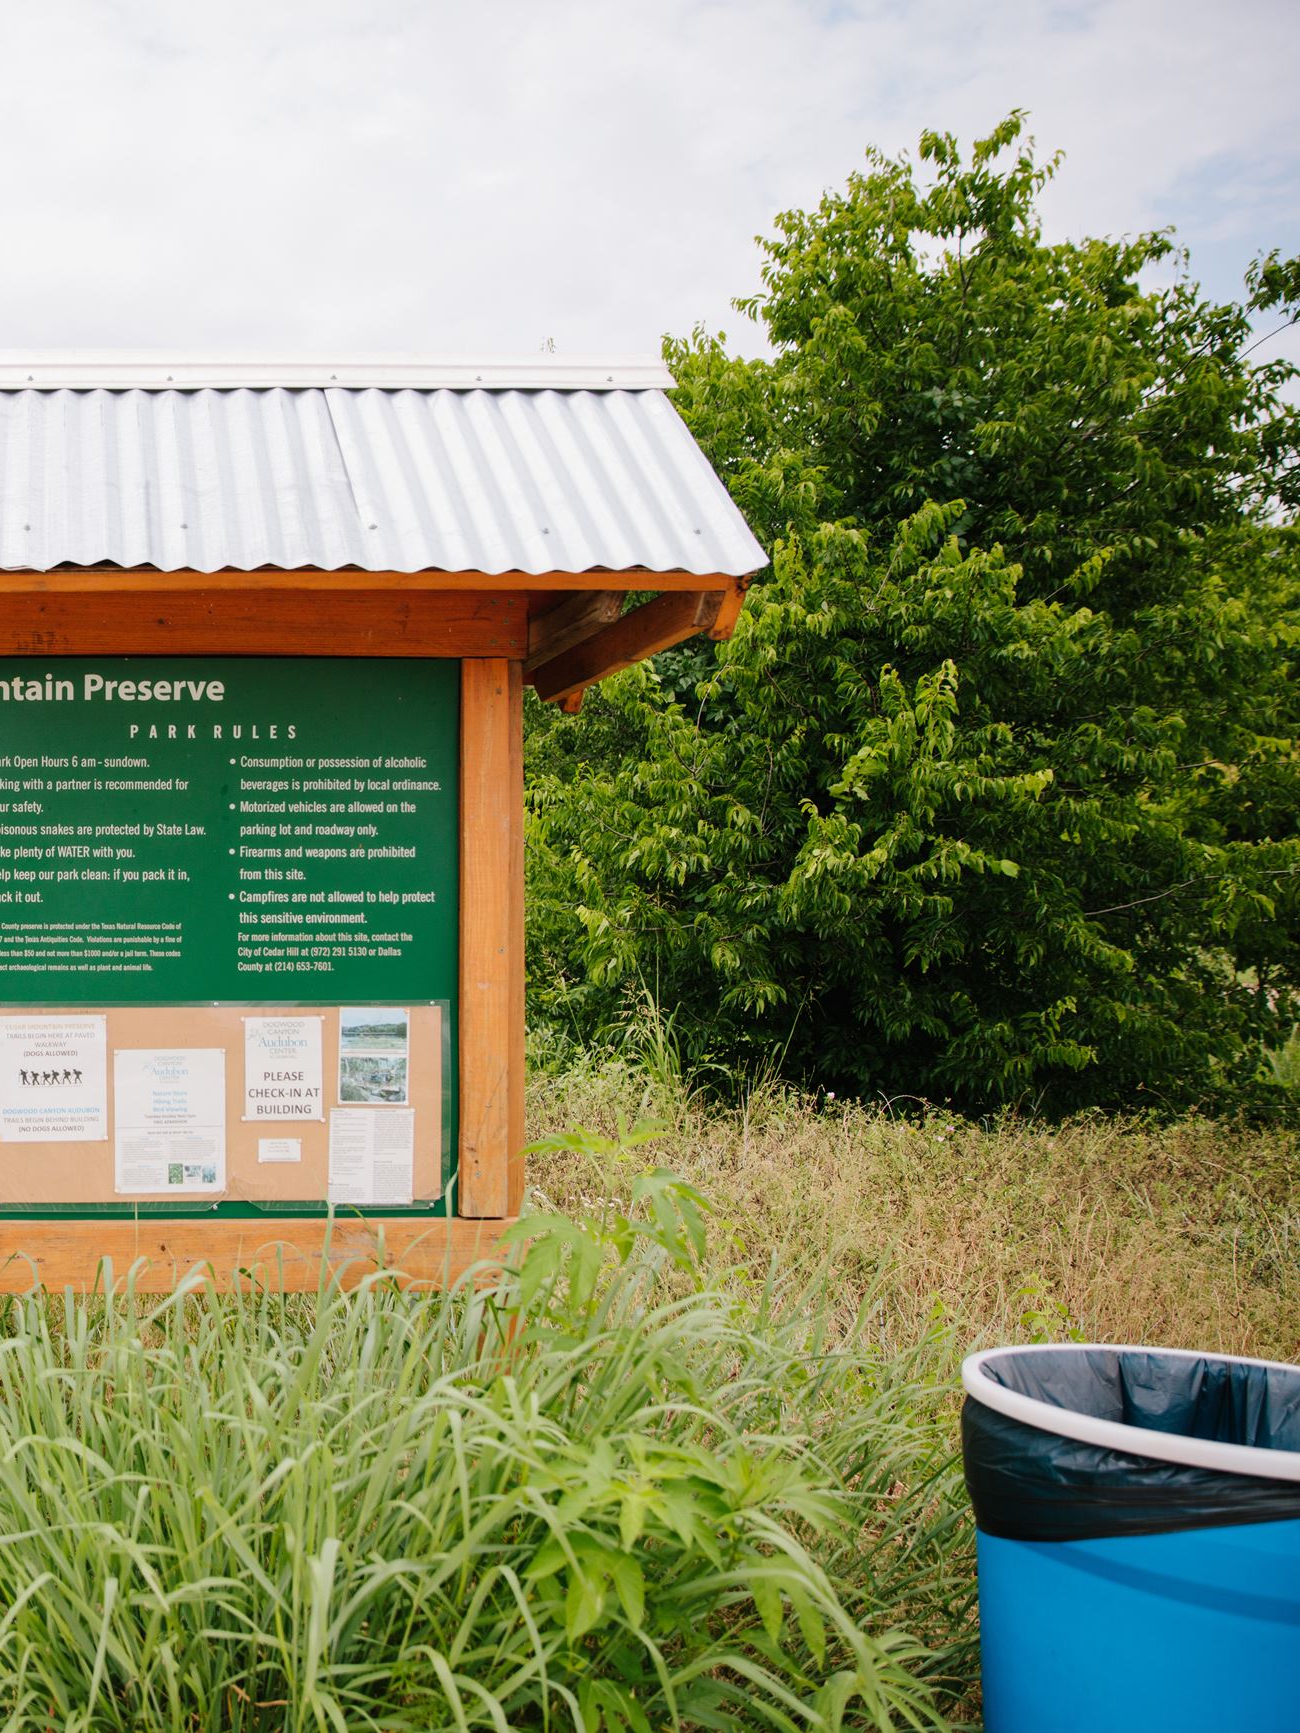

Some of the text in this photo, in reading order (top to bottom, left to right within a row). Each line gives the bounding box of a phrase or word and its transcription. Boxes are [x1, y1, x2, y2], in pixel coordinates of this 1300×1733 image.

[84, 674, 225, 701] Preserve
[130, 724, 296, 739] PARK RULES
[13, 755, 38, 769] Open
[41, 755, 69, 768] Hours
[71, 755, 78, 767] 6
[81, 758, 96, 768] am
[104, 756, 150, 768] sundown.
[240, 755, 427, 770] Consumption or possession of alcoholic
[241, 778, 441, 792] beverages is prohibited by local ordinance.
[40, 823, 74, 835] snakes
[76, 826, 93, 835] are
[95, 823, 140, 837] protected
[143, 824, 155, 837] by
[156, 823, 182, 835] State
[185, 824, 206, 835] Law.
[14, 846, 43, 860] plenty
[45, 846, 55, 858] of
[57, 845, 90, 858] WATER
[92, 846, 113, 858] with
[116, 848, 135, 860] you.
[239, 890, 435, 905] Campfires are not allowed to help protect
[239, 912, 367, 924] this sensitive environment.
[238, 932, 413, 943] For more information about this site, contact the
[237, 947, 253, 958] City
[253, 947, 262, 956] of
[263, 947, 285, 957] Cedar
[286, 947, 299, 956] Hill
[300, 947, 309, 956] at
[310, 947, 331, 957] (972)
[332, 947, 346, 956] 291
[348, 946, 367, 957] 5130
[378, 946, 402, 956] Dallas
[237, 961, 334, 973] County at (214) 653-7601.
[258, 1036, 307, 1047] Audubon
[264, 1071, 304, 1081] PLEASE
[248, 1088, 320, 1098] CHECK-IN AT
[257, 1104, 311, 1114] BUILDING
